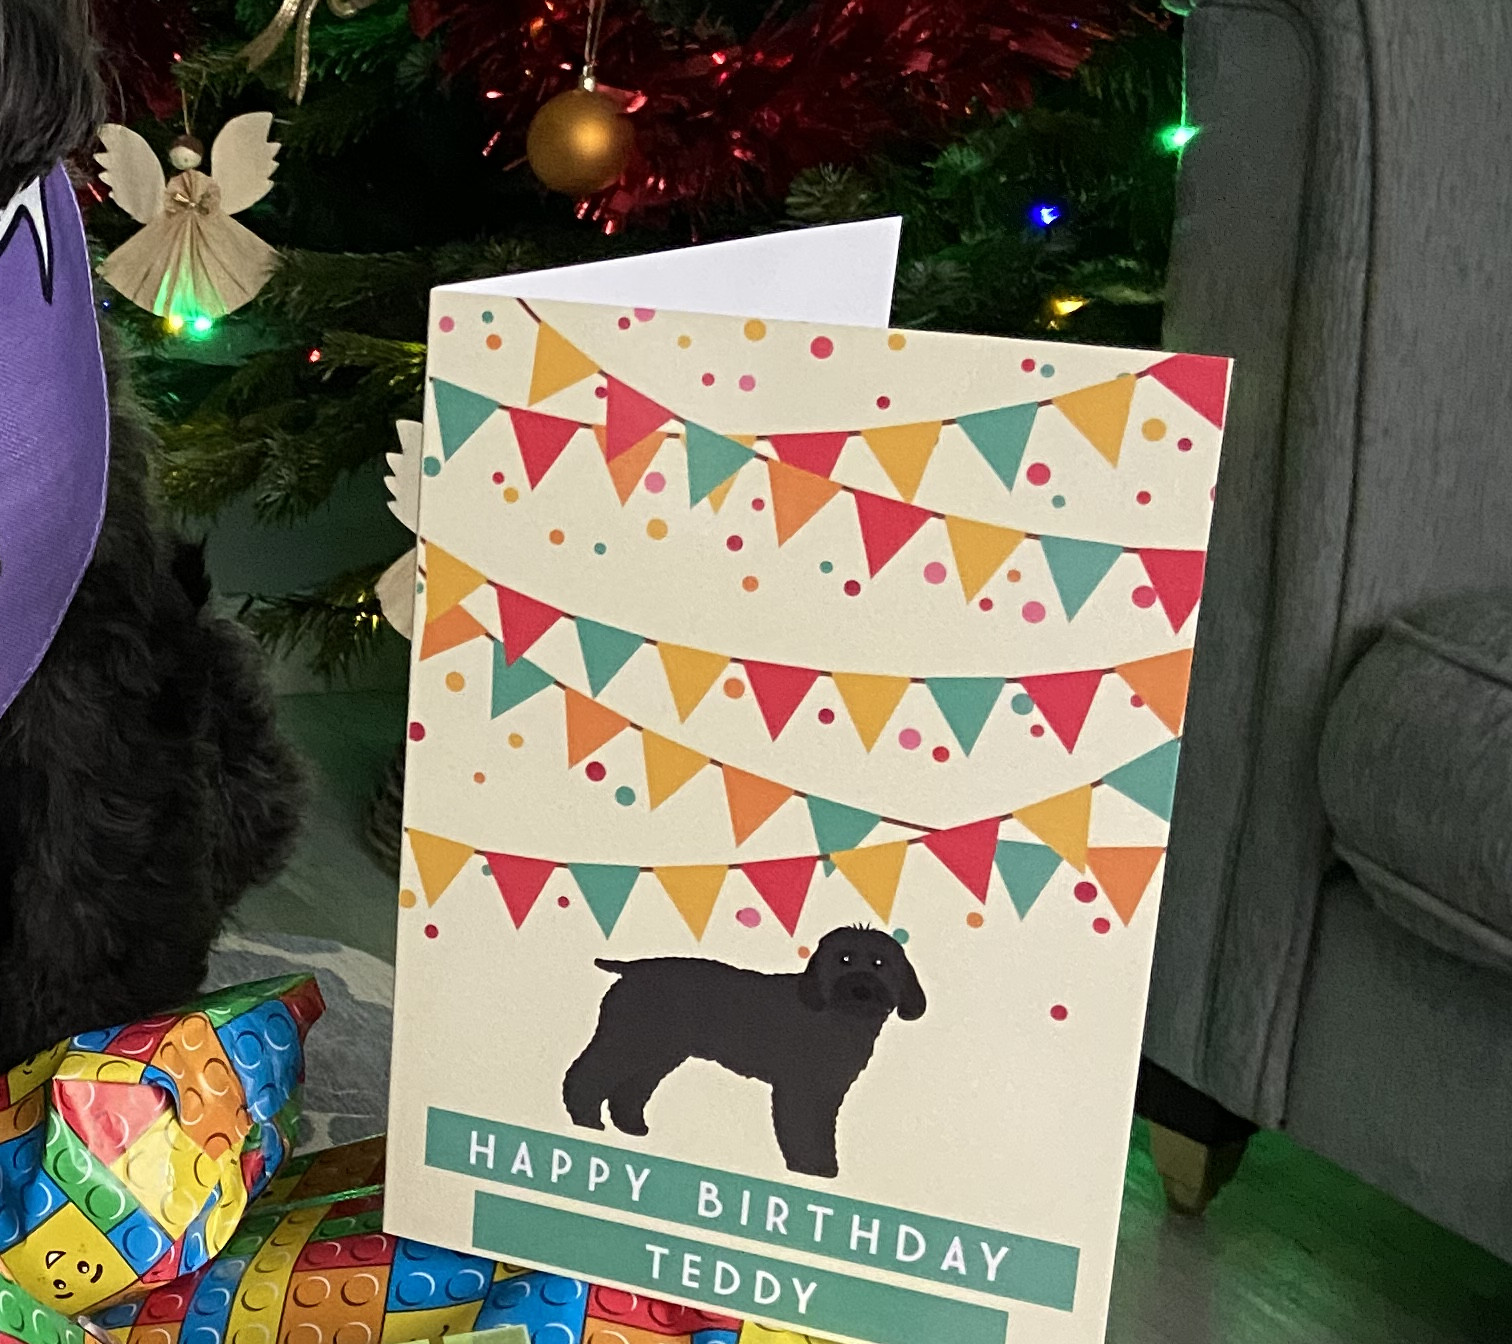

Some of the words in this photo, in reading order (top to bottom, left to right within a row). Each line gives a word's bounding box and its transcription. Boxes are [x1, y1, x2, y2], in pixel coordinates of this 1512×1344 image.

[469, 1130, 651, 1202] HAPPY
[697, 1181, 1010, 1282] BIRTHDAY
[644, 1243, 818, 1315] TEDDY
